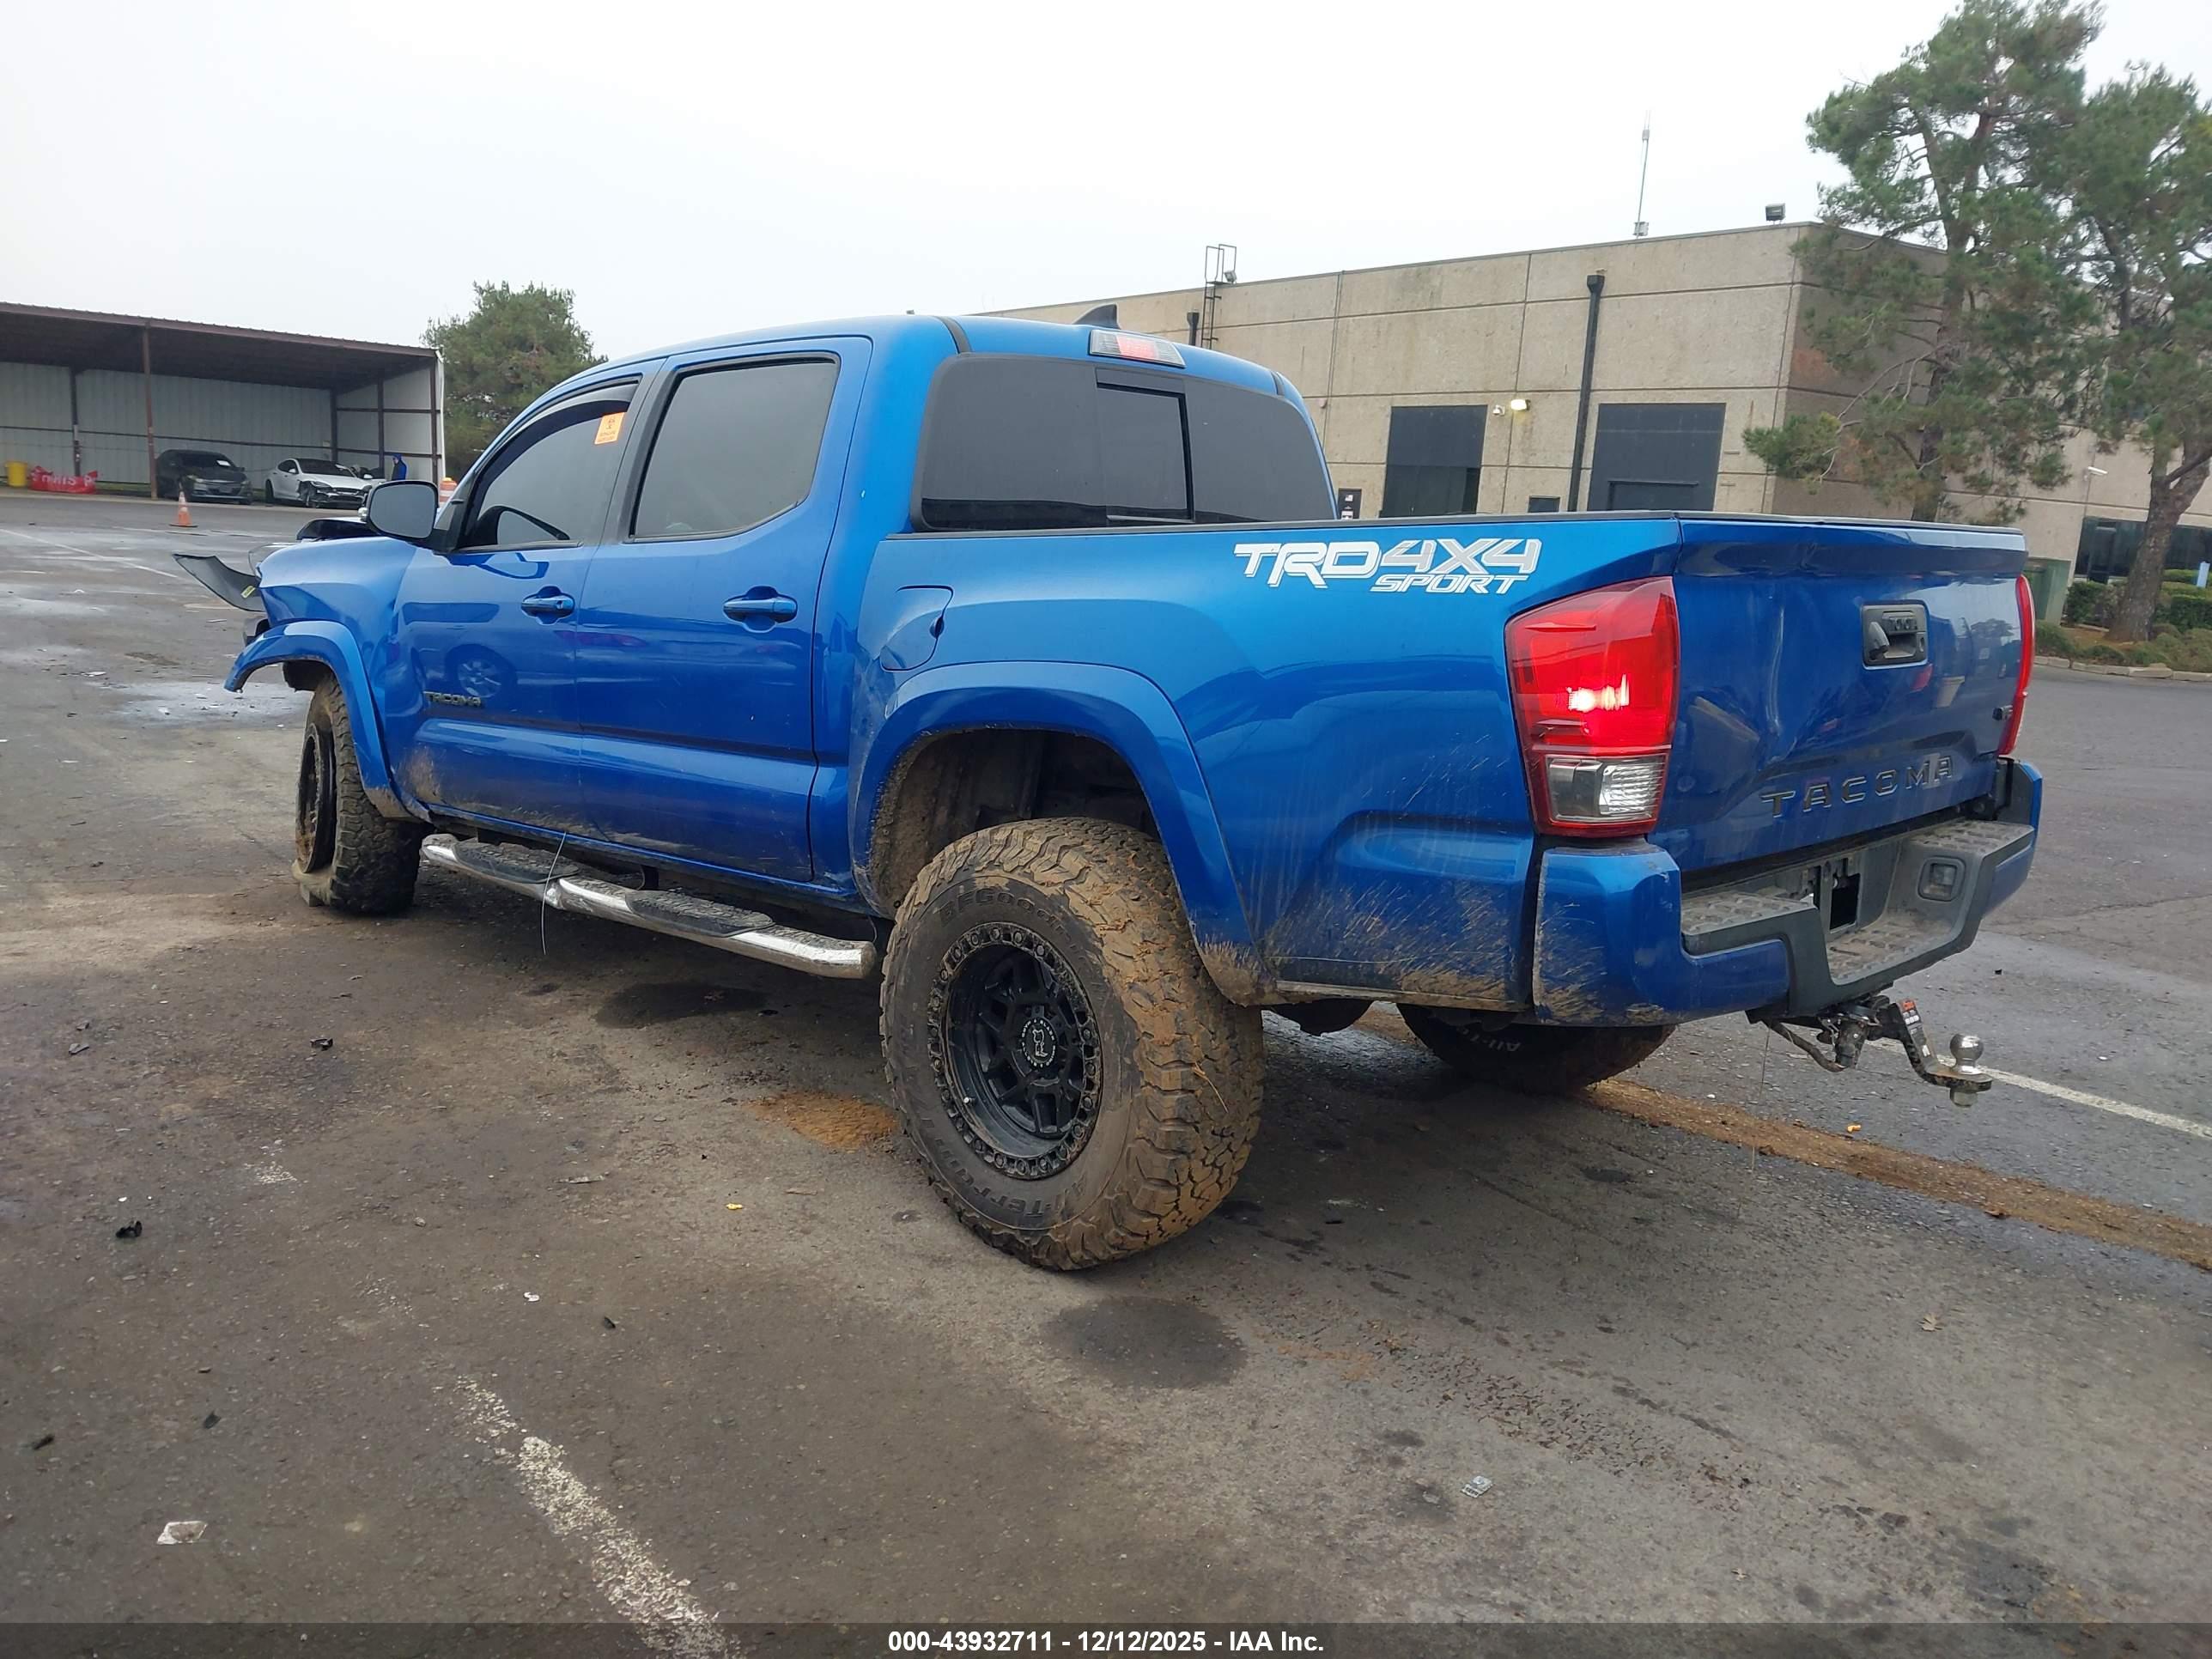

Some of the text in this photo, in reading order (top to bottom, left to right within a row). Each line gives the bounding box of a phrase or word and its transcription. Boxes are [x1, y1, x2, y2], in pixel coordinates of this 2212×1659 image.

[1234, 541, 1382, 588] TRD
[1370, 573, 1530, 594] SPORT
[1760, 756, 1954, 818] TACOMA
